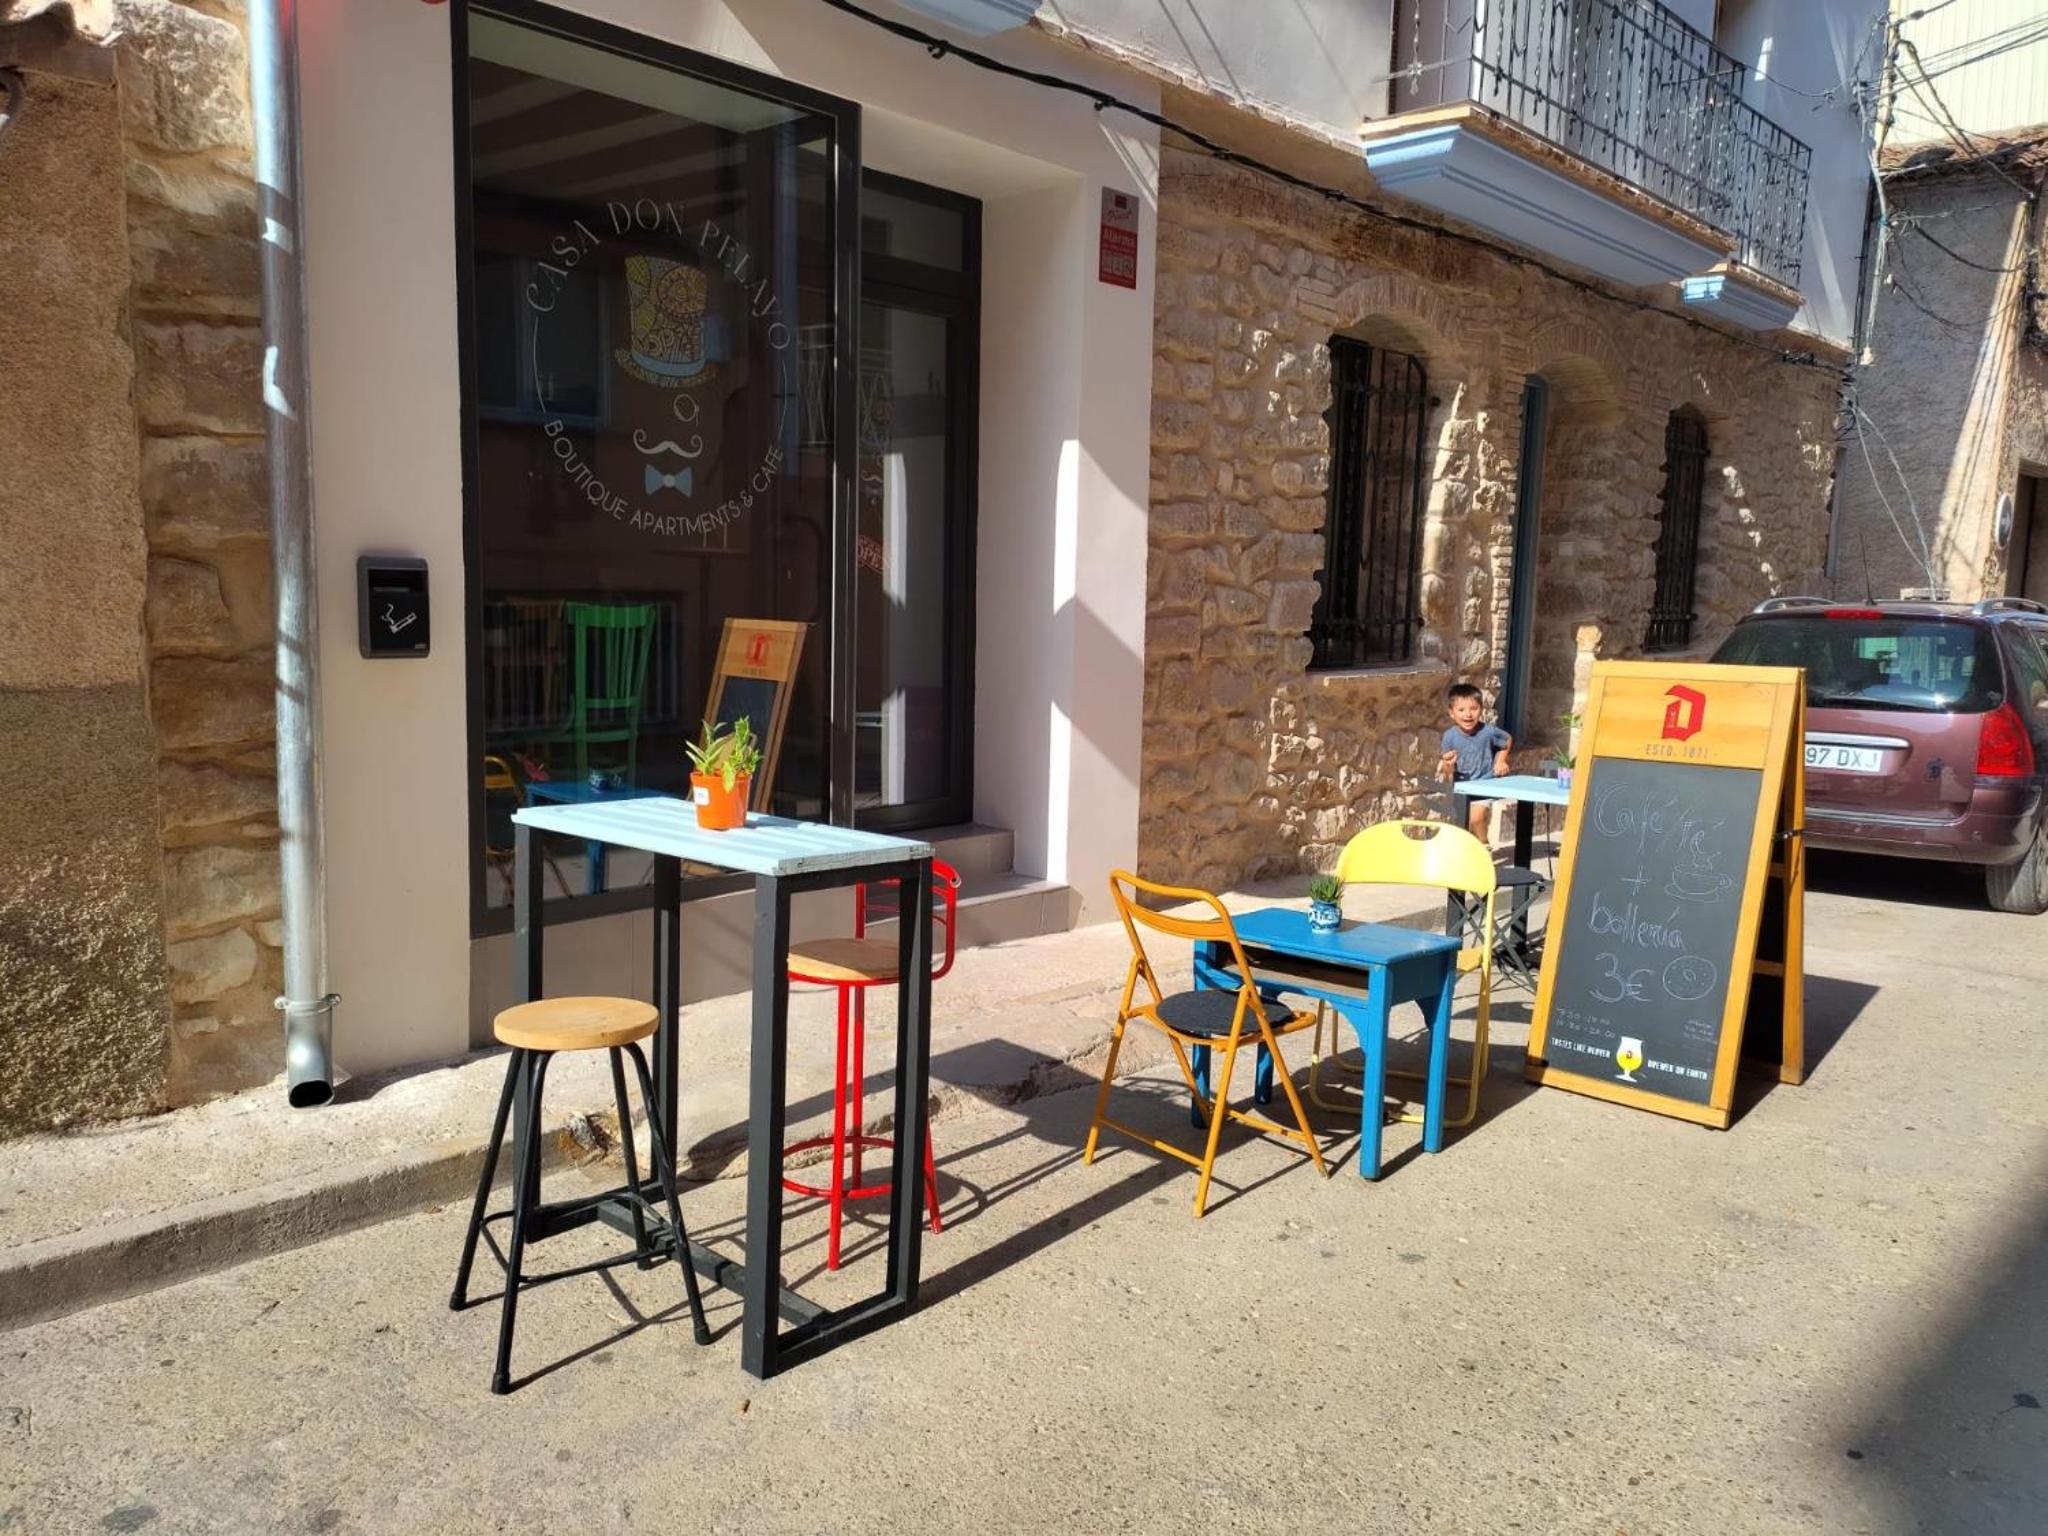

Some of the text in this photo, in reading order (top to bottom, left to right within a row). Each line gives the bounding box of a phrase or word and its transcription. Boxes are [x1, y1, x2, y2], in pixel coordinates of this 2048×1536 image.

[526, 198, 791, 350] CASA DON PELAYO
[544, 419, 628, 521] BOUTIQUE
[630, 500, 741, 537] APARTMENTS
